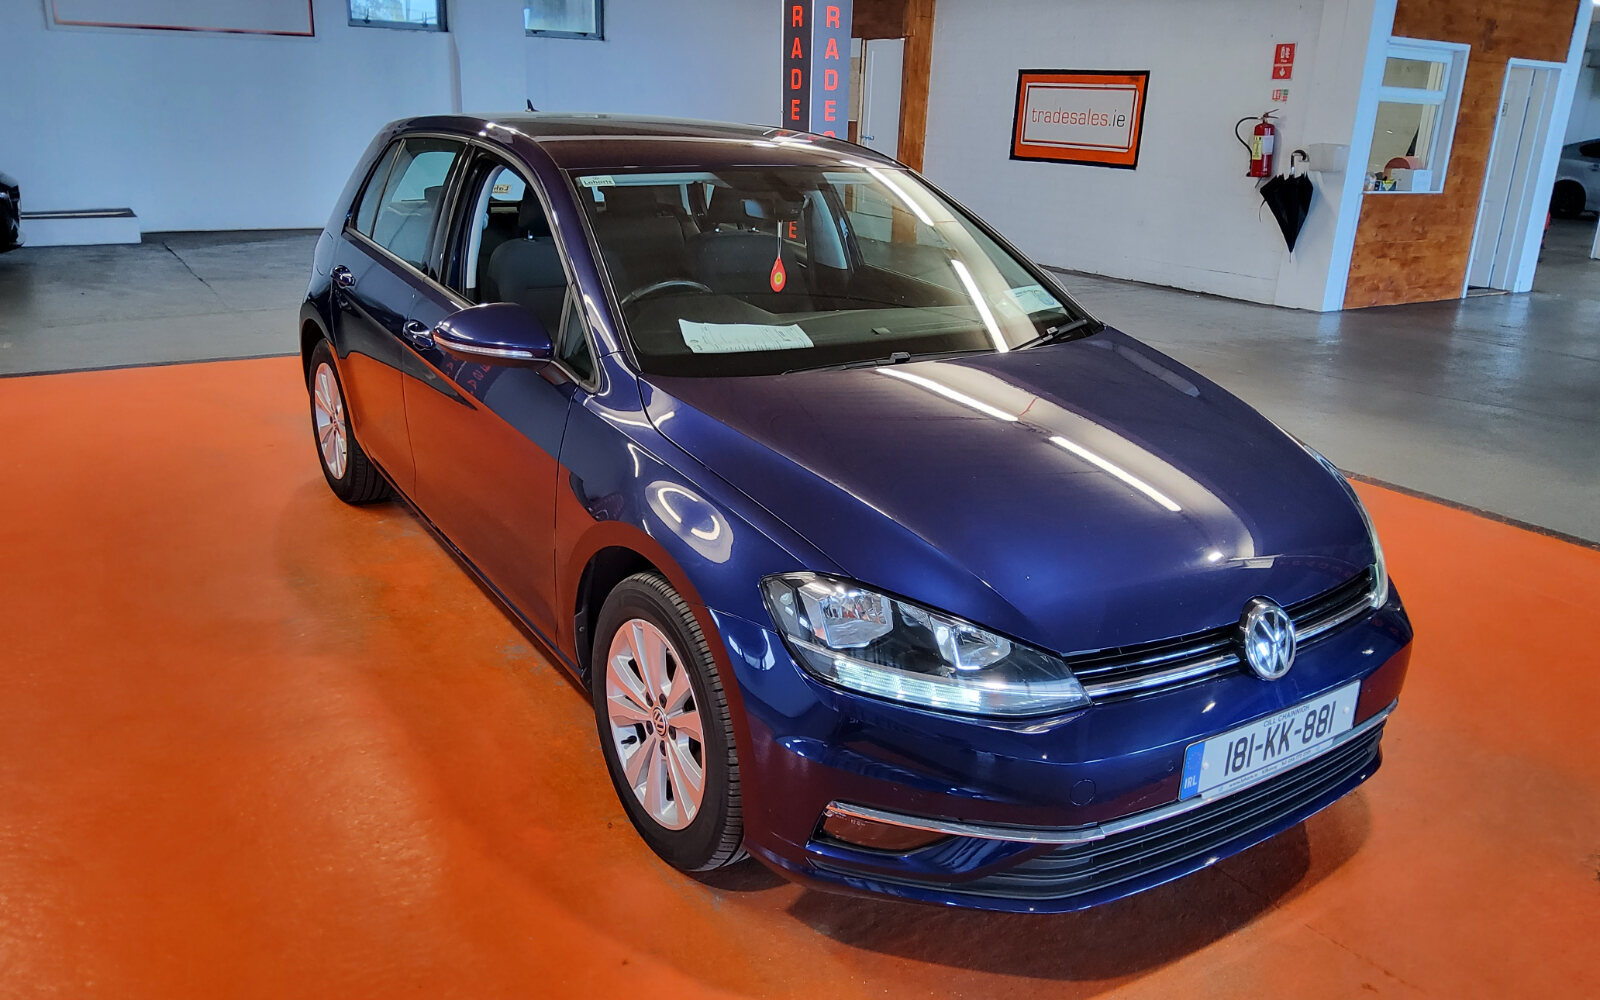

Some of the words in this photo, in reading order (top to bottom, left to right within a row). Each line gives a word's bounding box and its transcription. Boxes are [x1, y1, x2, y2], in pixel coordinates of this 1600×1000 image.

[1031, 107, 1126, 128] tradesales.ie
[1223, 701, 1337, 777] 181-KK-881
[1183, 775, 1198, 790] IRL
